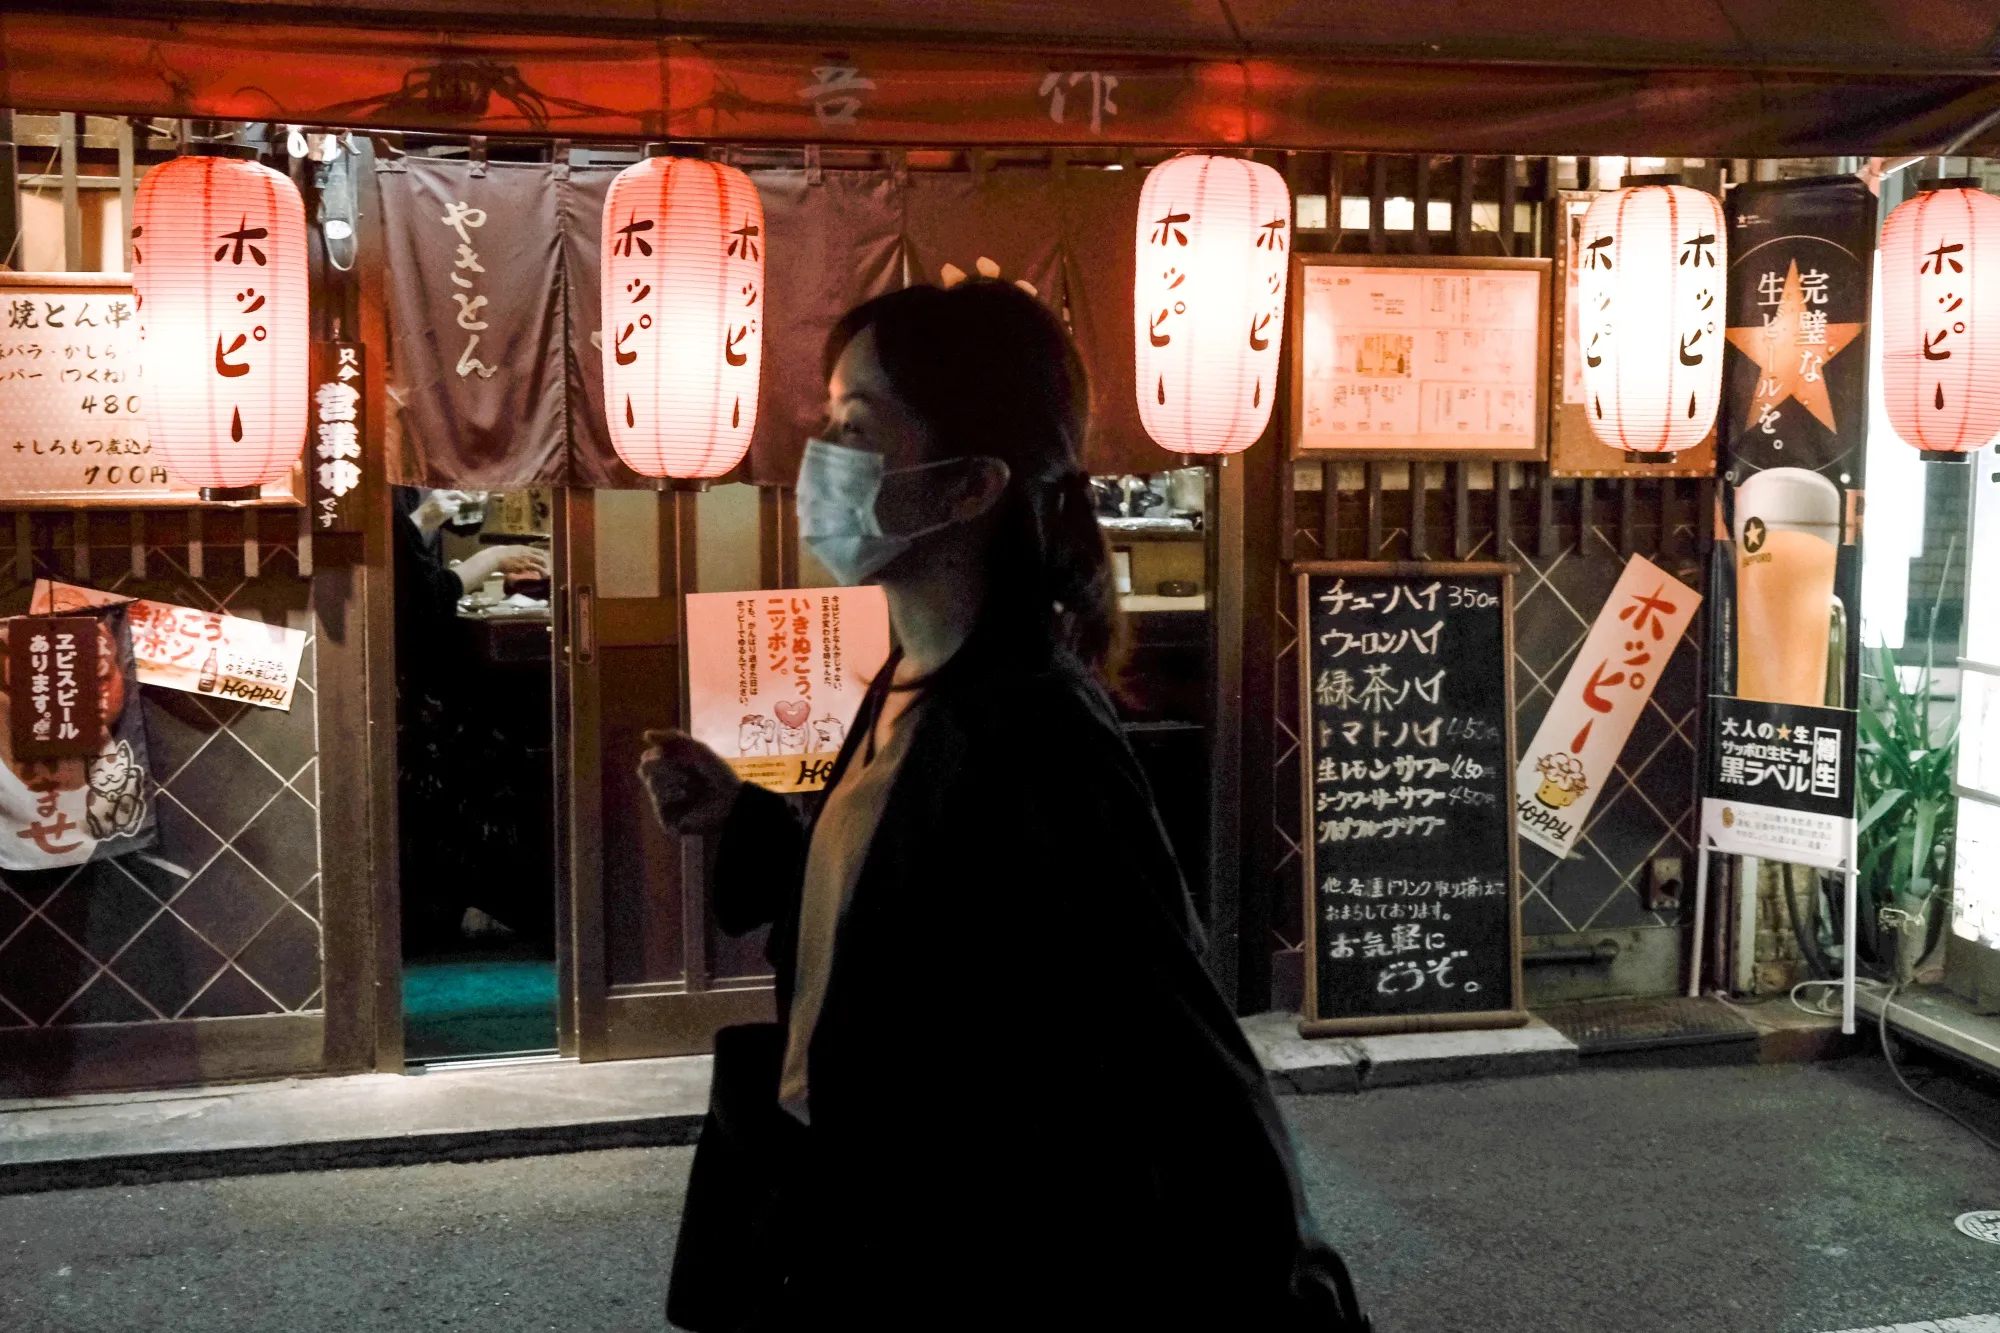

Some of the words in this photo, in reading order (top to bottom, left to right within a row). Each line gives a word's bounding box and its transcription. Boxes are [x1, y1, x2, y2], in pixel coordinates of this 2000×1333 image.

[8, 299, 133, 329] 焼とん串
[214, 212, 268, 442] ホッピー
[441, 201, 498, 377] やきとん
[614, 208, 654, 428] ホッピー
[725, 212, 759, 428] ホッピー
[1150, 203, 1191, 406] ホッピー
[1250, 208, 1287, 409] ホッピー
[1679, 224, 1716, 420] ホッピー
[1797, 268, 1830, 383] 完璧な
[1920, 235, 1965, 410] ホッピー
[1757, 271, 1786, 450] 生ビールを。
[84, 465, 168, 485] 700円
[767, 598, 788, 675] ニッポン。
[1320, 578, 1442, 615] チューハイ
[29, 634, 51, 718] あります。
[790, 597, 812, 700] いきぬこう、
[1320, 620, 1445, 658] ウーロンハイ
[1568, 583, 1678, 755] ホッピー
[219, 678, 288, 706] Hoppy
[1315, 663, 1446, 714] 緑茶ハイ
[1316, 754, 1450, 783] 生レモンサワー
[1319, 716, 1444, 748] トマトハイ
[1721, 740, 1812, 765] サッポロ生ビール
[1719, 756, 1811, 793] 黒ラベル
[1329, 923, 1446, 958] お気軽に
[1376, 950, 1482, 994] どうぞ。
